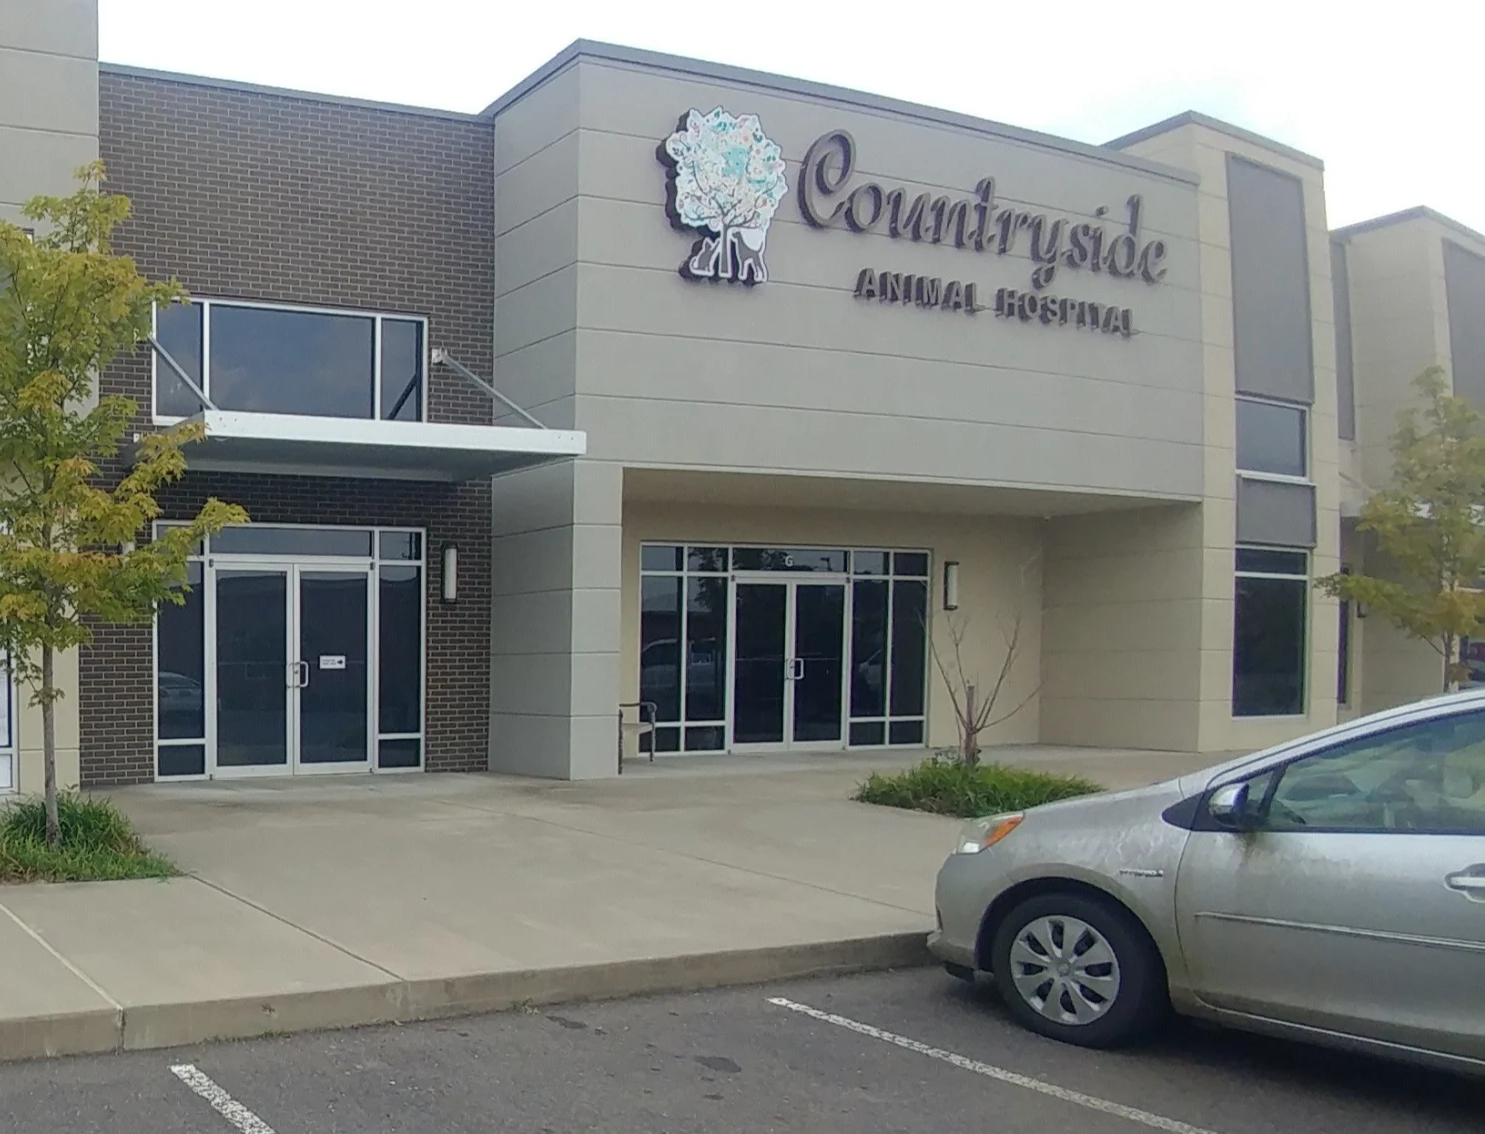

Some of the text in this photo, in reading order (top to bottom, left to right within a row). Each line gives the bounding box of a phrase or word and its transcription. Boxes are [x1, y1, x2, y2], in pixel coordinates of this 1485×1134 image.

[797, 129, 1167, 290] Countryside
[854, 267, 1136, 338] ANIMAL HOSPITAL
[785, 555, 793, 567] G
